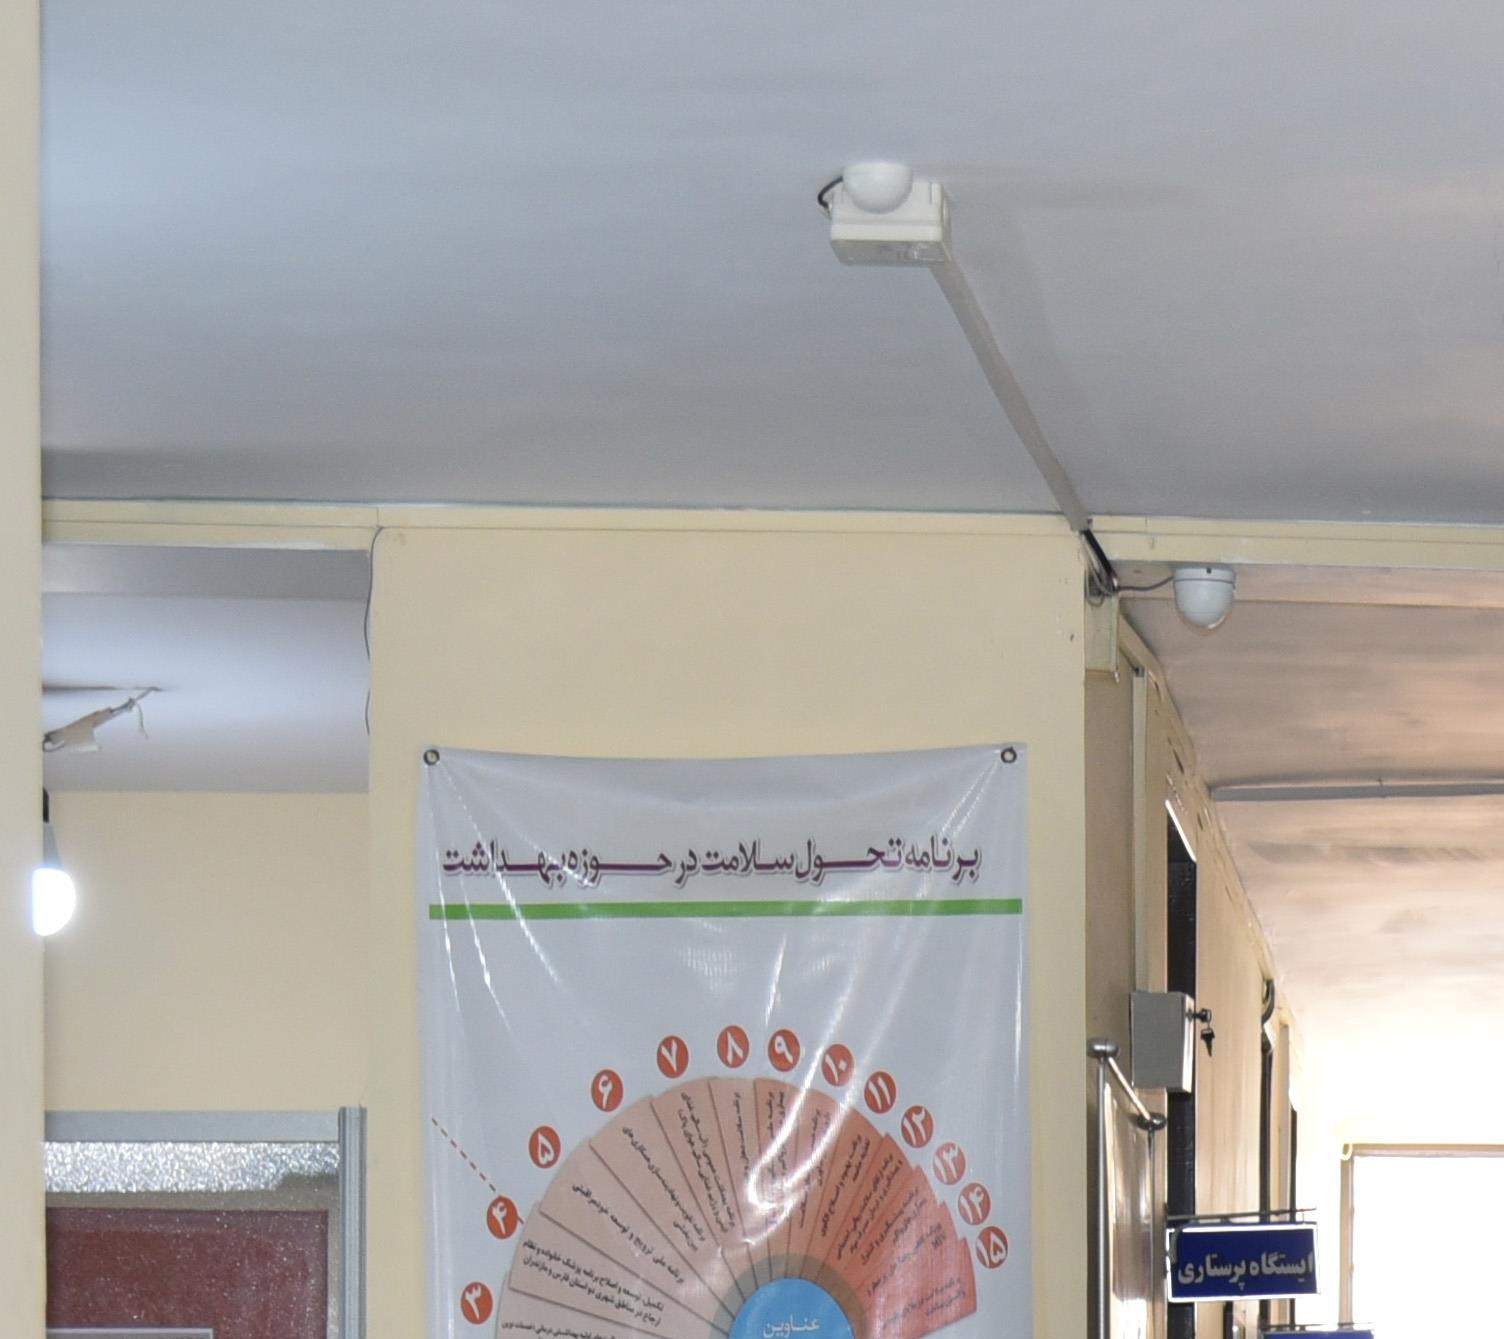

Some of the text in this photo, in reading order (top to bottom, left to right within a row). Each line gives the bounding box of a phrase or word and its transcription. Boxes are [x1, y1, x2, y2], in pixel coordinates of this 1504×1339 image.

[442, 841, 566, 889] بهداشت
[675, 848, 698, 887] در
[702, 840, 794, 875] سلامت
[795, 836, 902, 886] تحول
[905, 837, 983, 883] برنامه
[1178, 1252, 1314, 1290] ایستگاه پرستاری
[763, 1314, 821, 1338] عناوین
